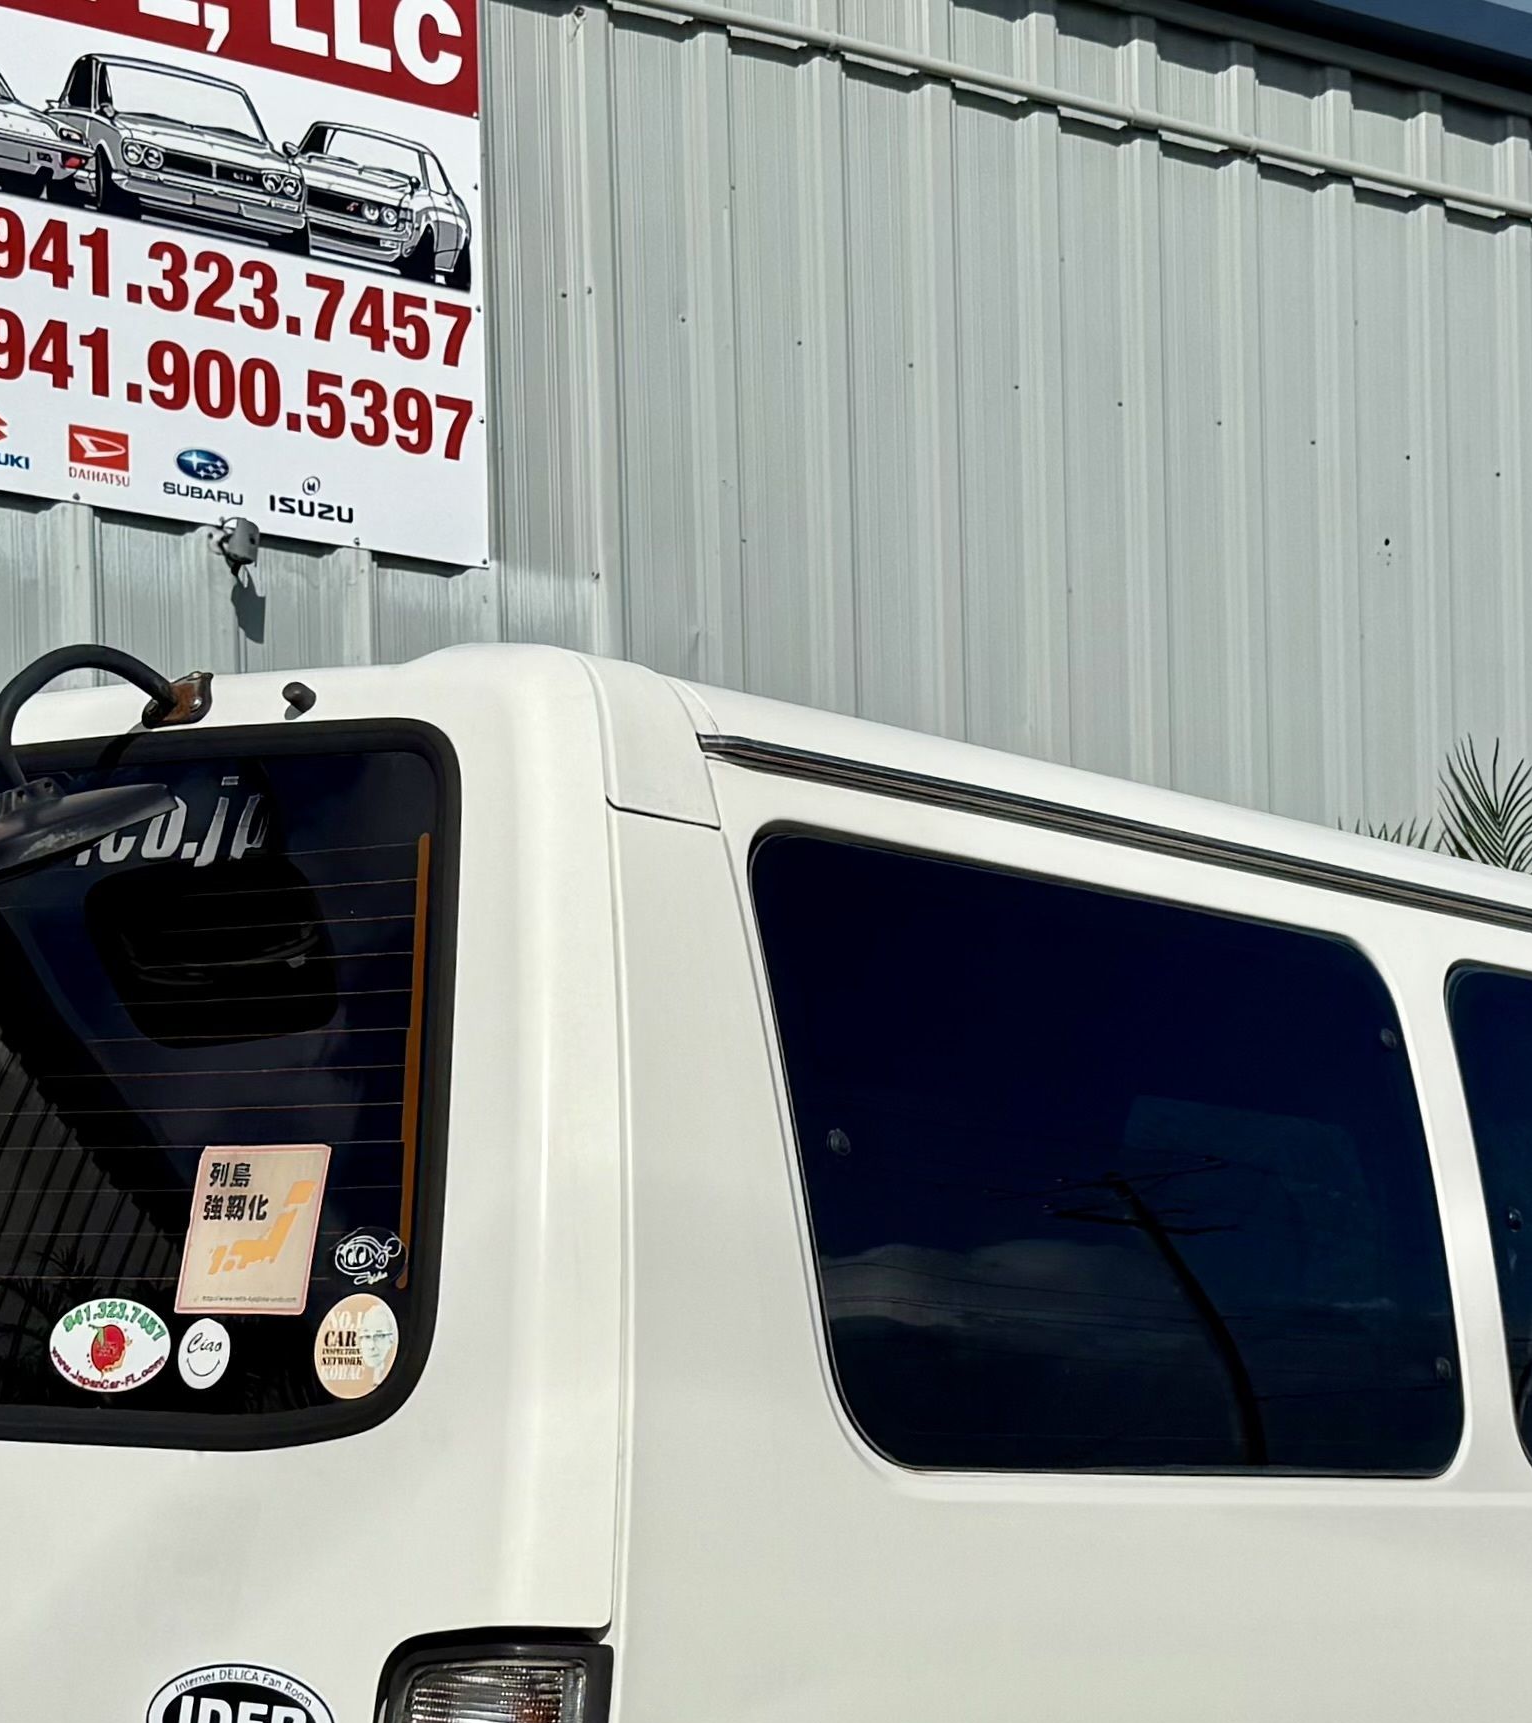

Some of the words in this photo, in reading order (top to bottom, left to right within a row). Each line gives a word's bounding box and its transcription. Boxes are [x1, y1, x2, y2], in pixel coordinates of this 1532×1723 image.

[69, 466, 130, 487] DAIHATSU
[163, 482, 243, 506] SUBARU
[269, 496, 354, 524] ISUZU
[210, 1162, 251, 1187] 列島
[187, 1332, 222, 1354] Ciao
[324, 1330, 357, 1347] CAR
[321, 1356, 363, 1366] NETWORK
[175, 1672, 215, 1693] Internet
[219, 1669, 259, 1682] DELICA
[262, 1674, 282, 1689] Fan
[284, 1681, 312, 1708] Room
